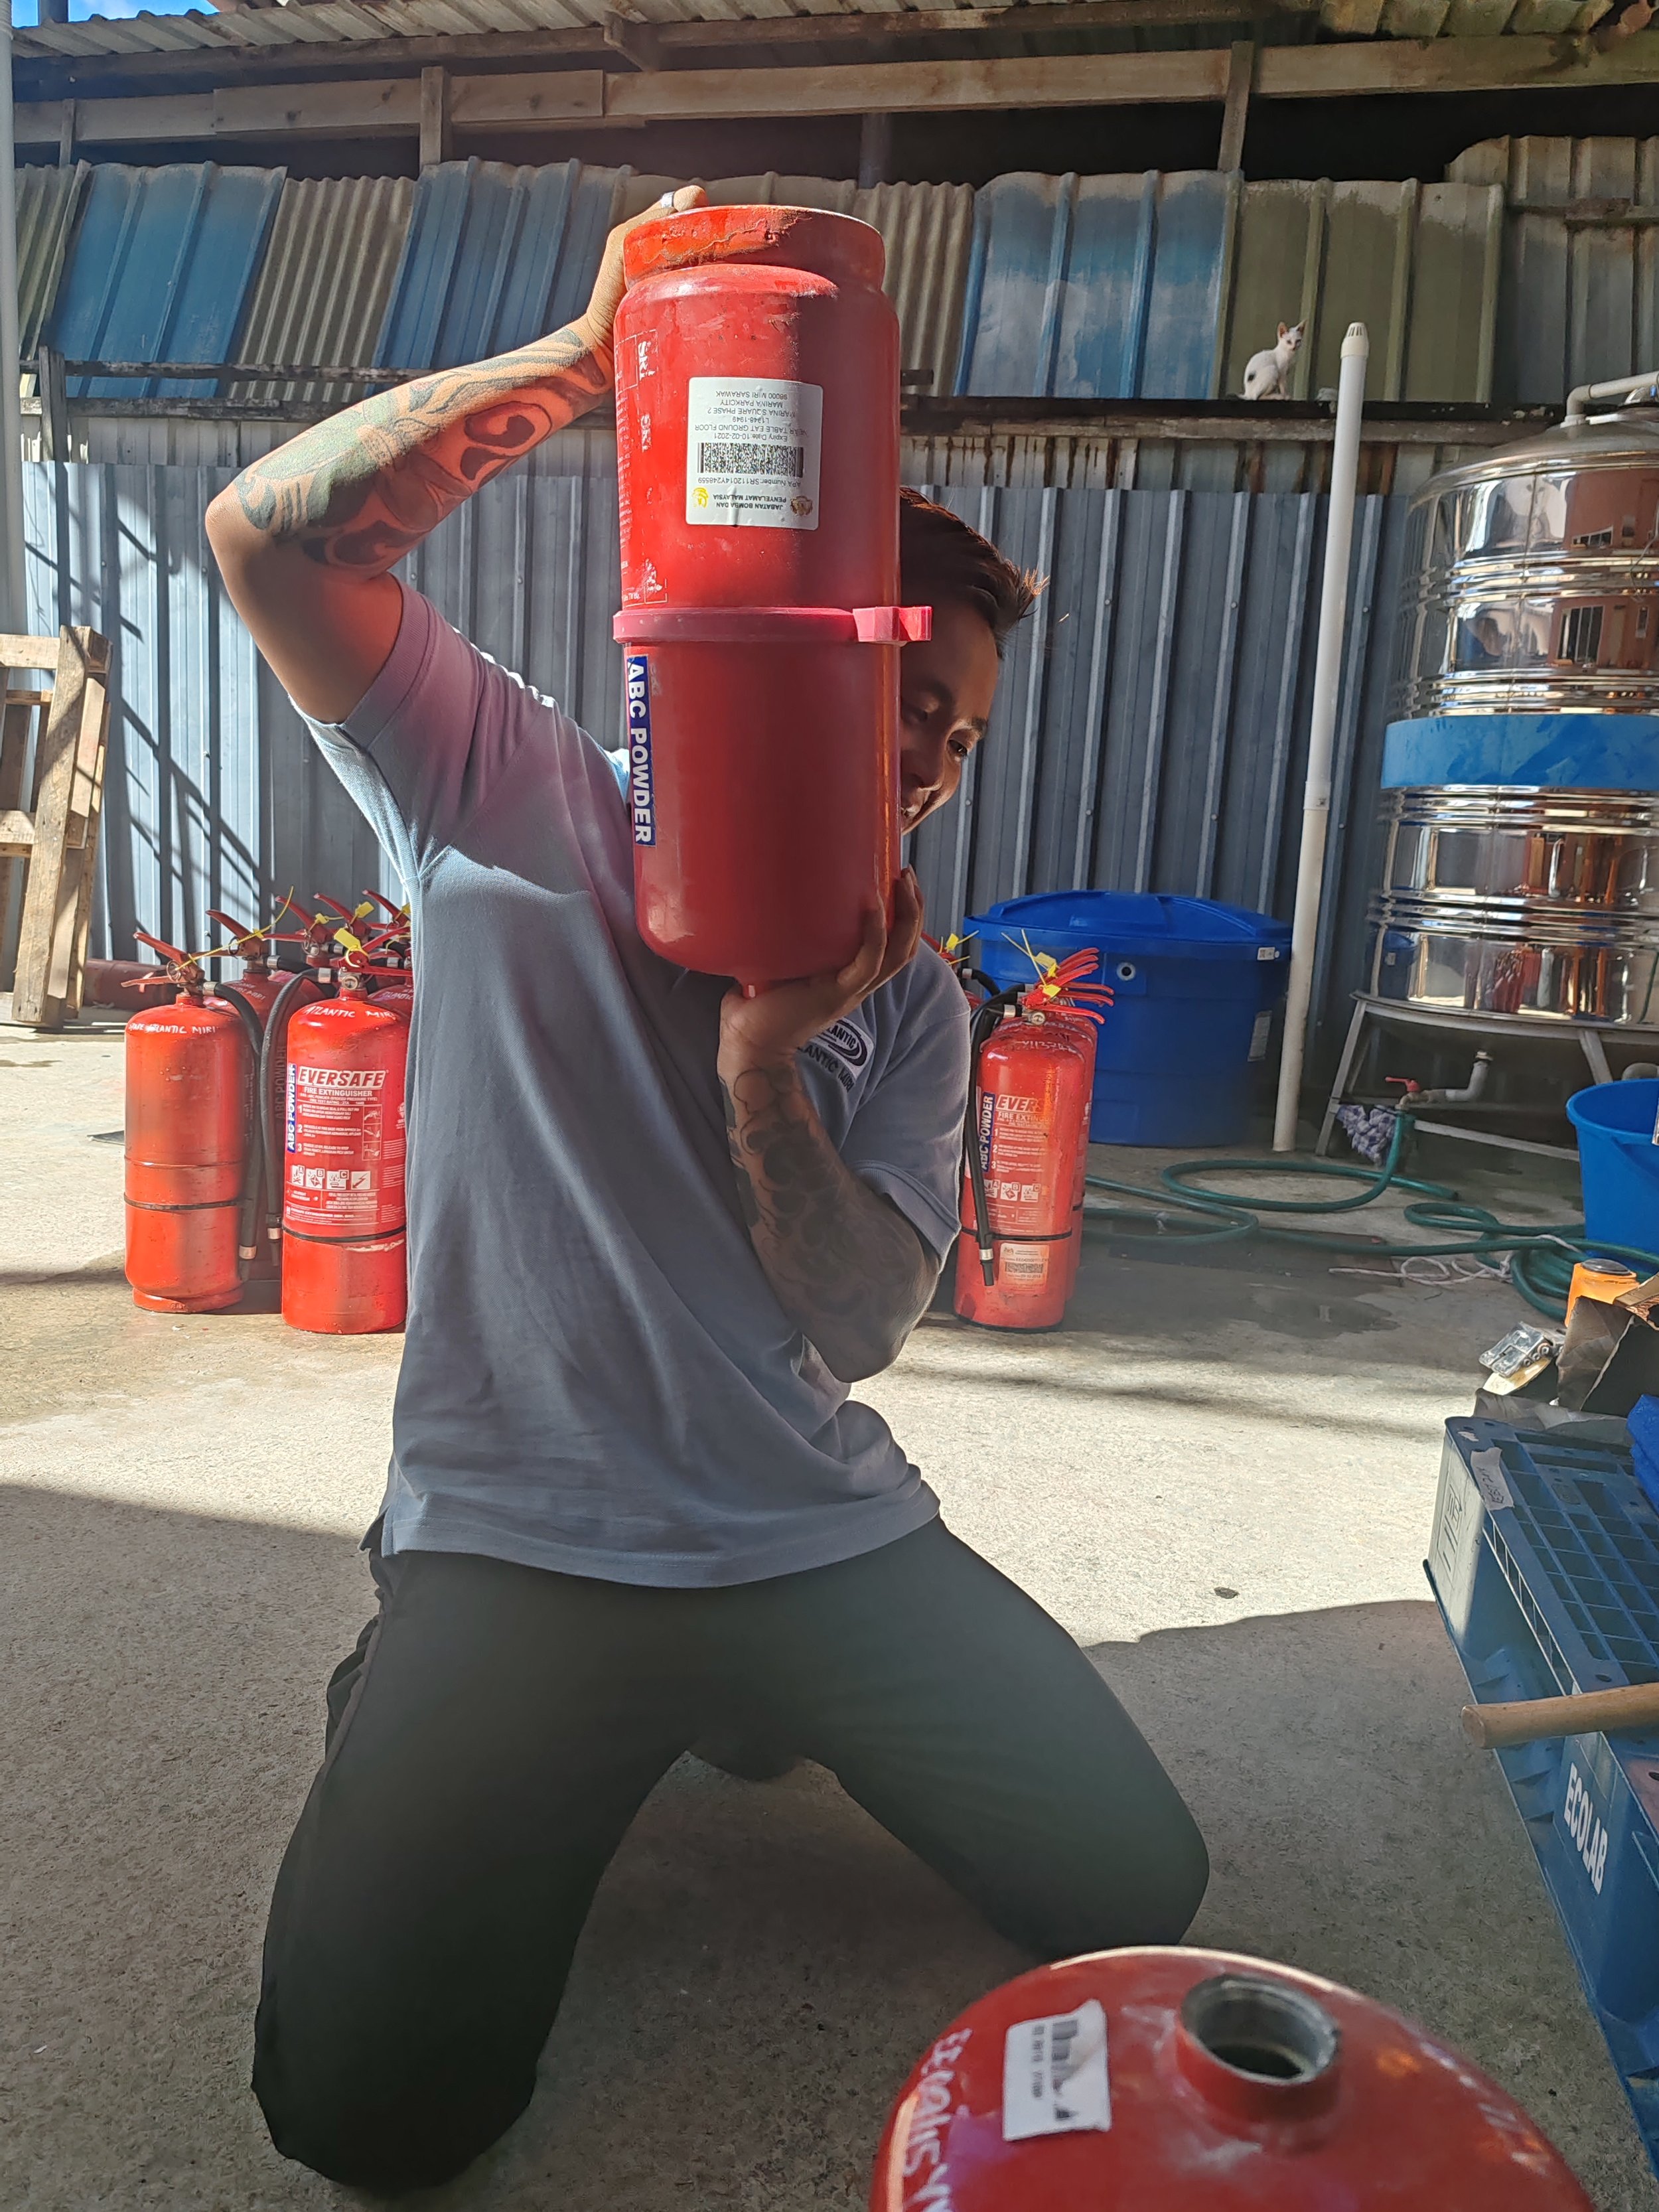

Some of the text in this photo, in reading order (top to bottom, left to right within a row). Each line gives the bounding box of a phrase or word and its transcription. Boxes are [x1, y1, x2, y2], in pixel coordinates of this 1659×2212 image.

[627, 661, 652, 842] ABC POWDER
[303, 1005, 355, 1017] ATLANTIC
[192, 1026, 216, 1035] MIRI
[299, 1068, 385, 1087] EVERSAFE
[319, 1088, 372, 1097] EXTINGUISHER
[979, 1095, 993, 1143] POWDER
[298, 1124, 302, 1133] 2
[1564, 1762, 1608, 1895] ECOLAB
